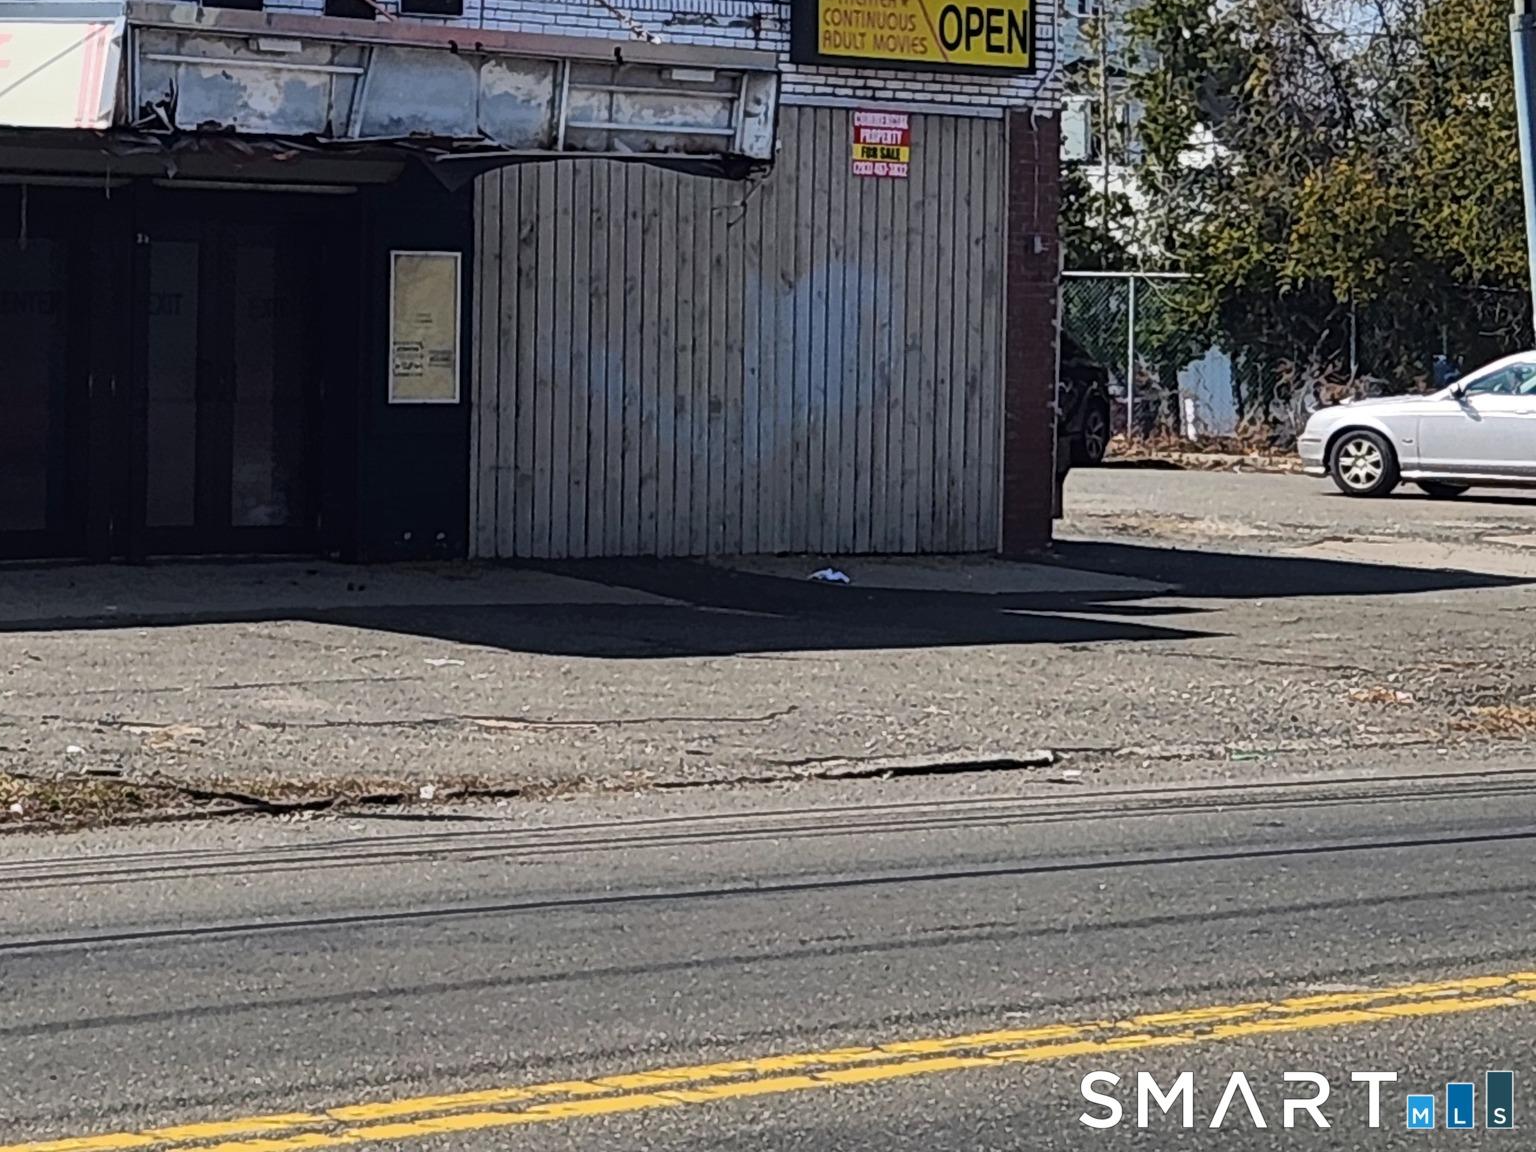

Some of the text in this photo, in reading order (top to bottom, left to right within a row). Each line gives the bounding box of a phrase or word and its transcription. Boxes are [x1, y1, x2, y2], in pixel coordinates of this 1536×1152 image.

[822, 7, 917, 33] CONTINUOUS
[938, 4, 1028, 55] OPEN
[822, 29, 929, 56] ADULT MOVIES
[861, 145, 901, 161] FOR SALE
